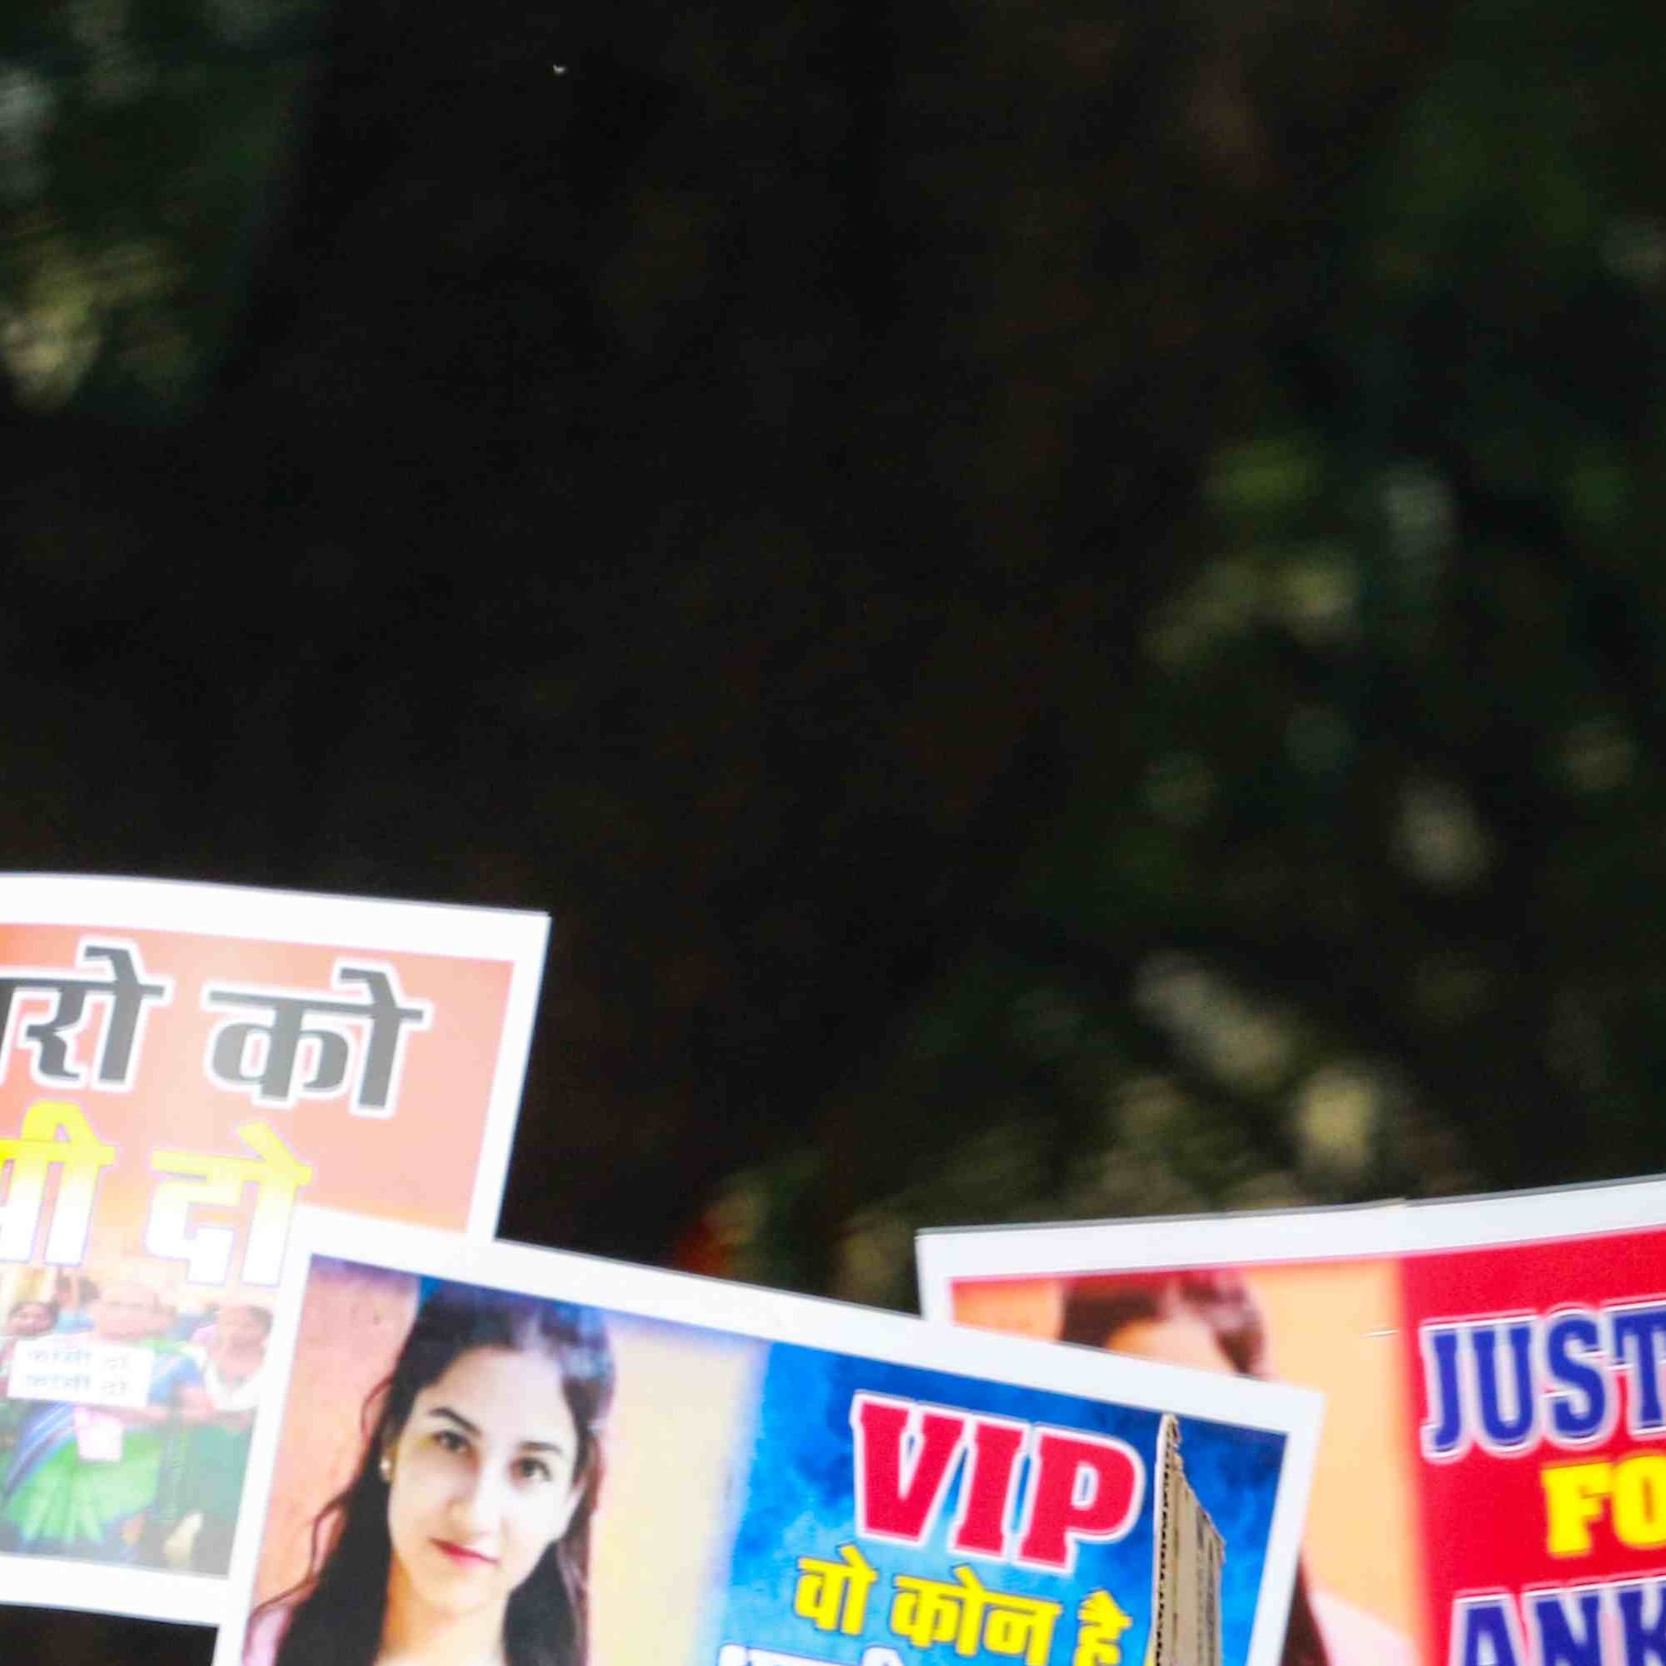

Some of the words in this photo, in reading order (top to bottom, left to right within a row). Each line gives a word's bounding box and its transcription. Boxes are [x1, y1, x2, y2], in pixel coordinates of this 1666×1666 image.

[204, 958, 433, 1118] को
[146, 1121, 312, 1288] दो
[850, 1390, 1146, 1577] VIP
[795, 1545, 878, 1635] वो
